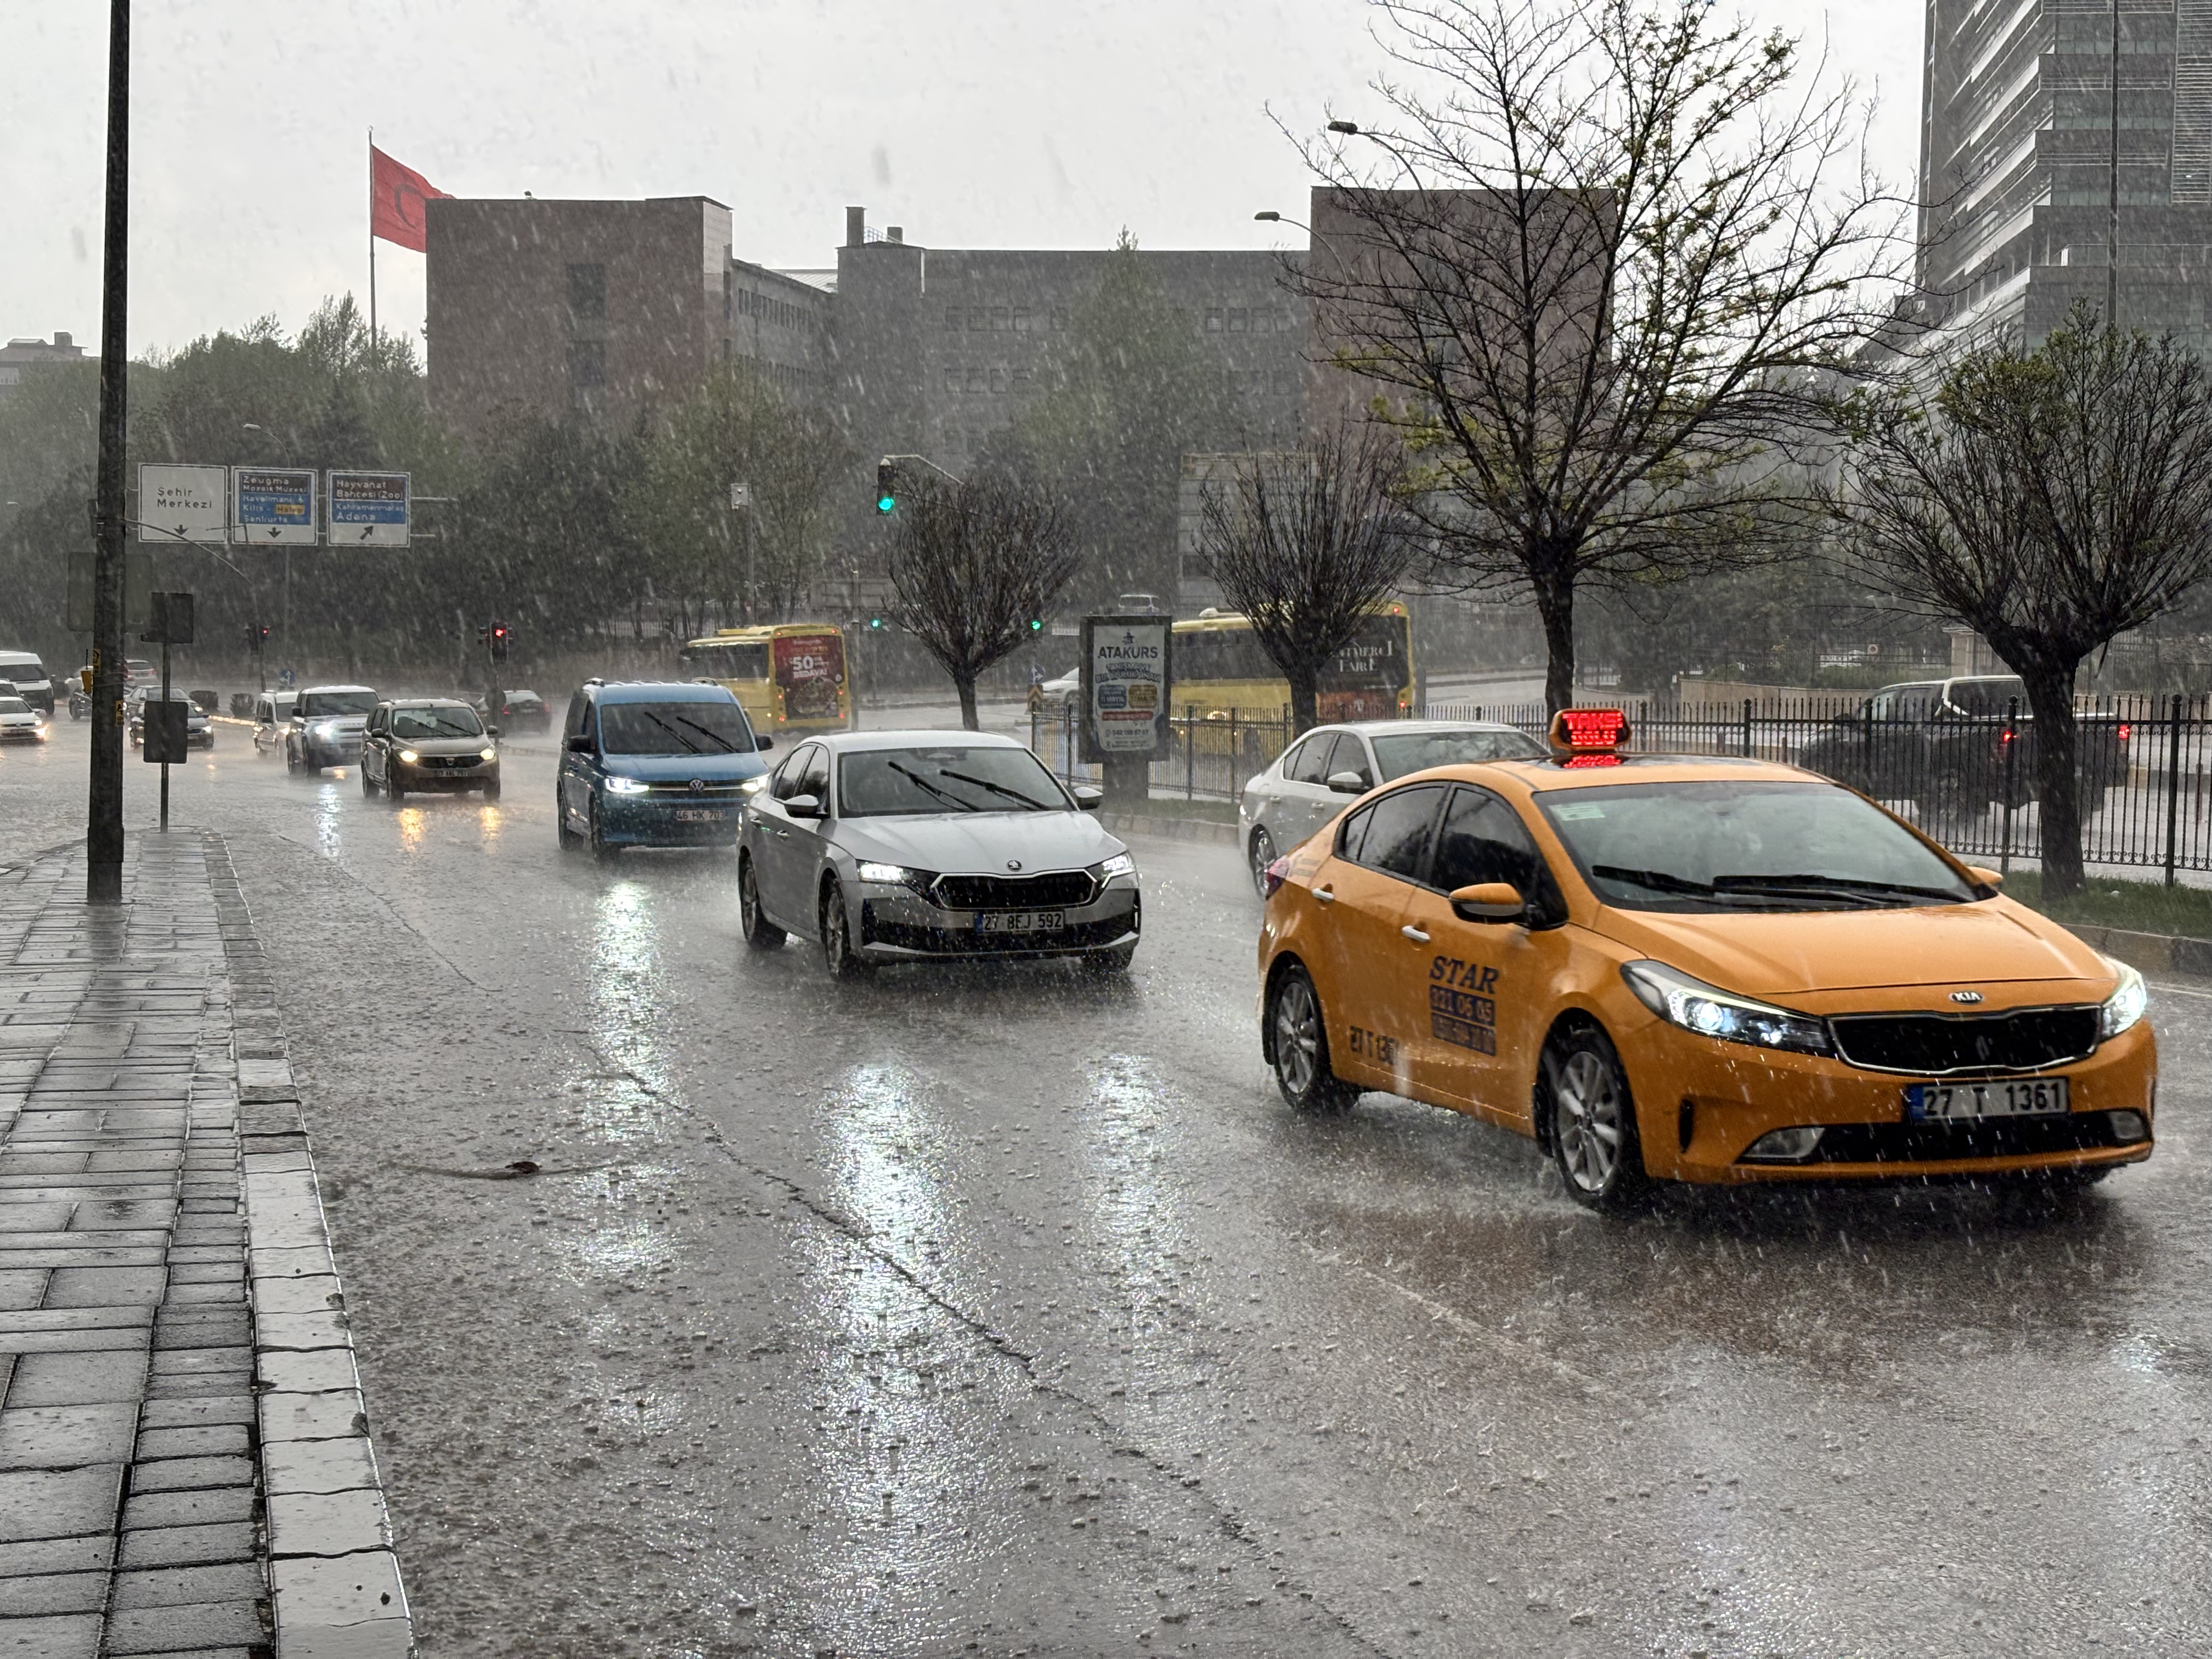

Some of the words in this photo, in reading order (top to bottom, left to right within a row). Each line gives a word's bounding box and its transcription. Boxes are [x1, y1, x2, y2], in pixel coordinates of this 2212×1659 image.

[244, 476, 289, 486] Zeugma
[336, 479, 386, 489] Hayvanat
[378, 490, 404, 500] (Zoo)
[157, 499, 212, 509] Merkezi
[336, 512, 376, 521] Adana
[1098, 646, 1158, 658] ATAKURS
[793, 656, 814, 670] 50
[678, 811, 689, 820] 46
[984, 916, 998, 930] 27
[1038, 913, 1062, 928] 592
[1429, 955, 1499, 994] STAR
[1955, 991, 1983, 1001] KIA
[1925, 1088, 1953, 1116] 27
[1972, 1086, 1986, 1113] T
[2006, 1082, 2062, 1111] 1361
